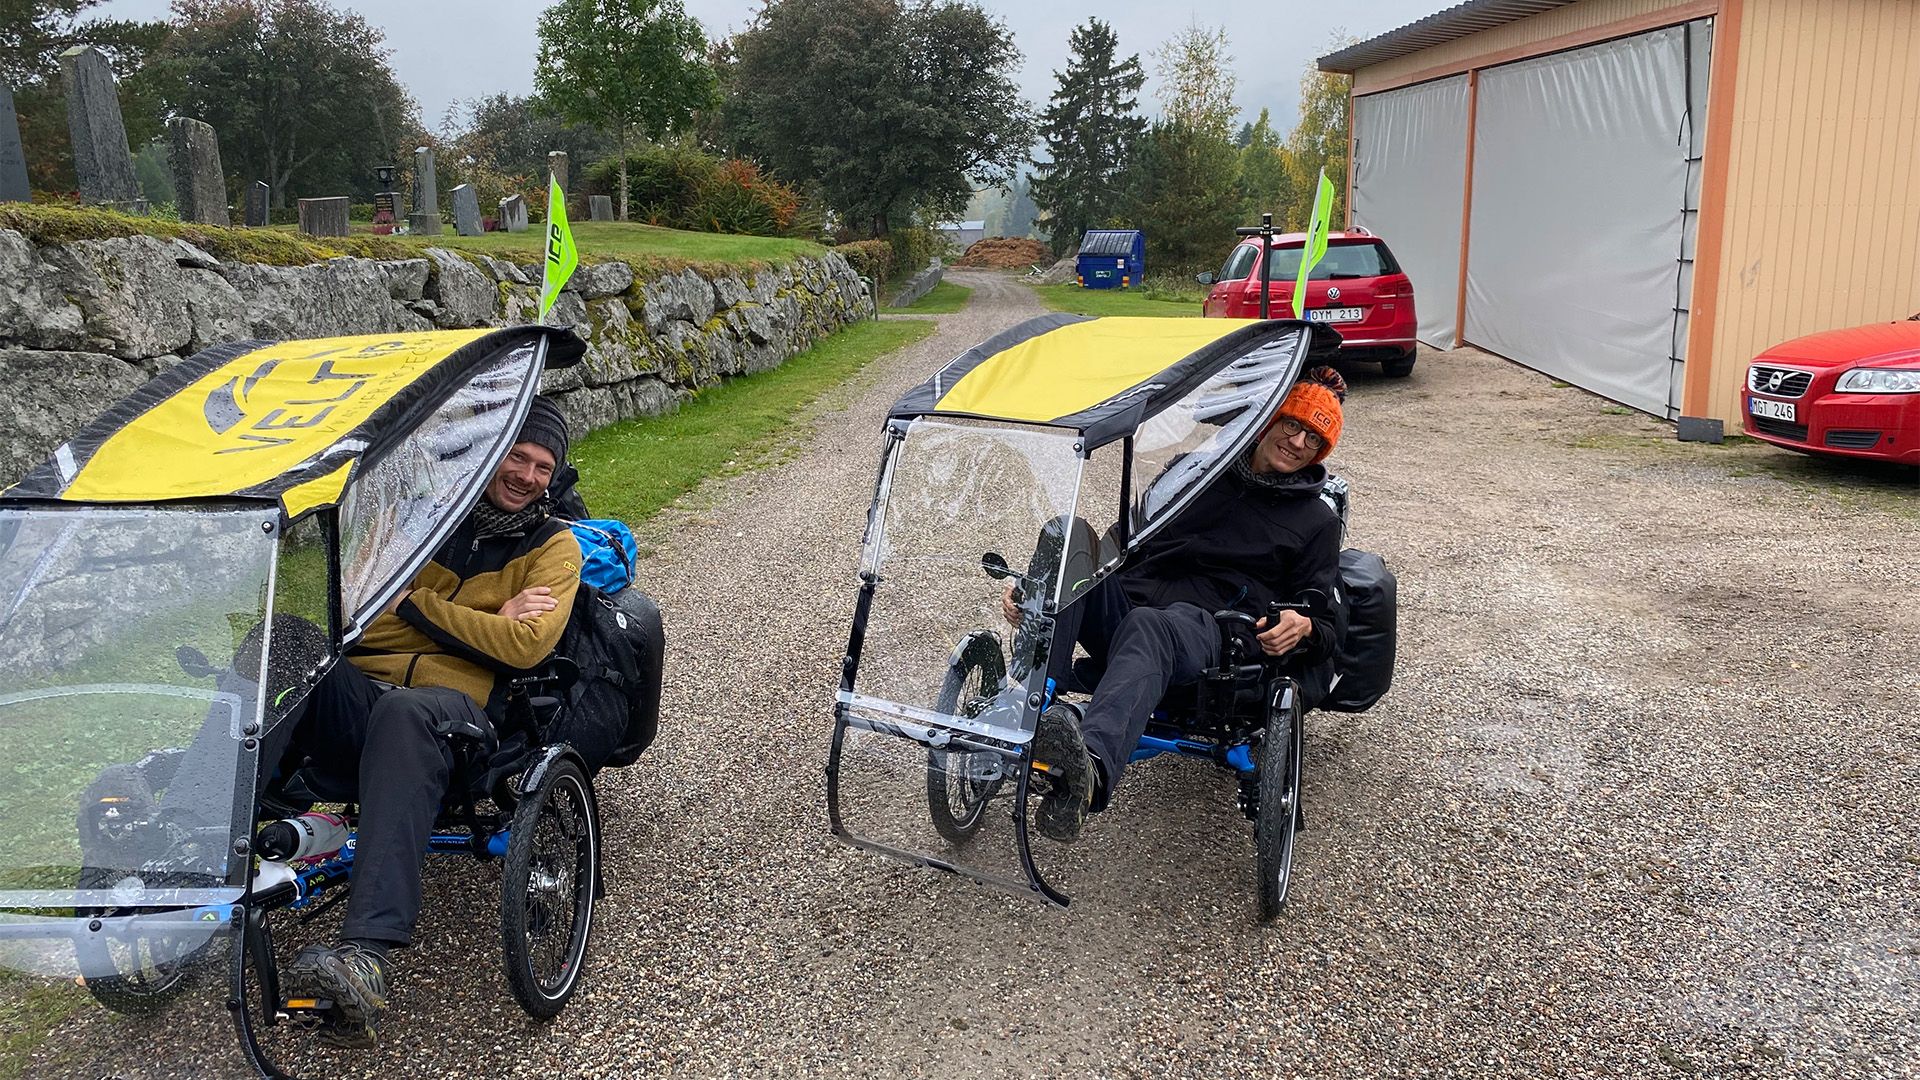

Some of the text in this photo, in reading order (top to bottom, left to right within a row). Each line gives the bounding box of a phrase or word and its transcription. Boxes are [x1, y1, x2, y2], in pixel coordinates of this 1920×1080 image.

[1311, 309, 1360, 320] OYM 213
[1753, 400, 1793, 419] MGT 246
